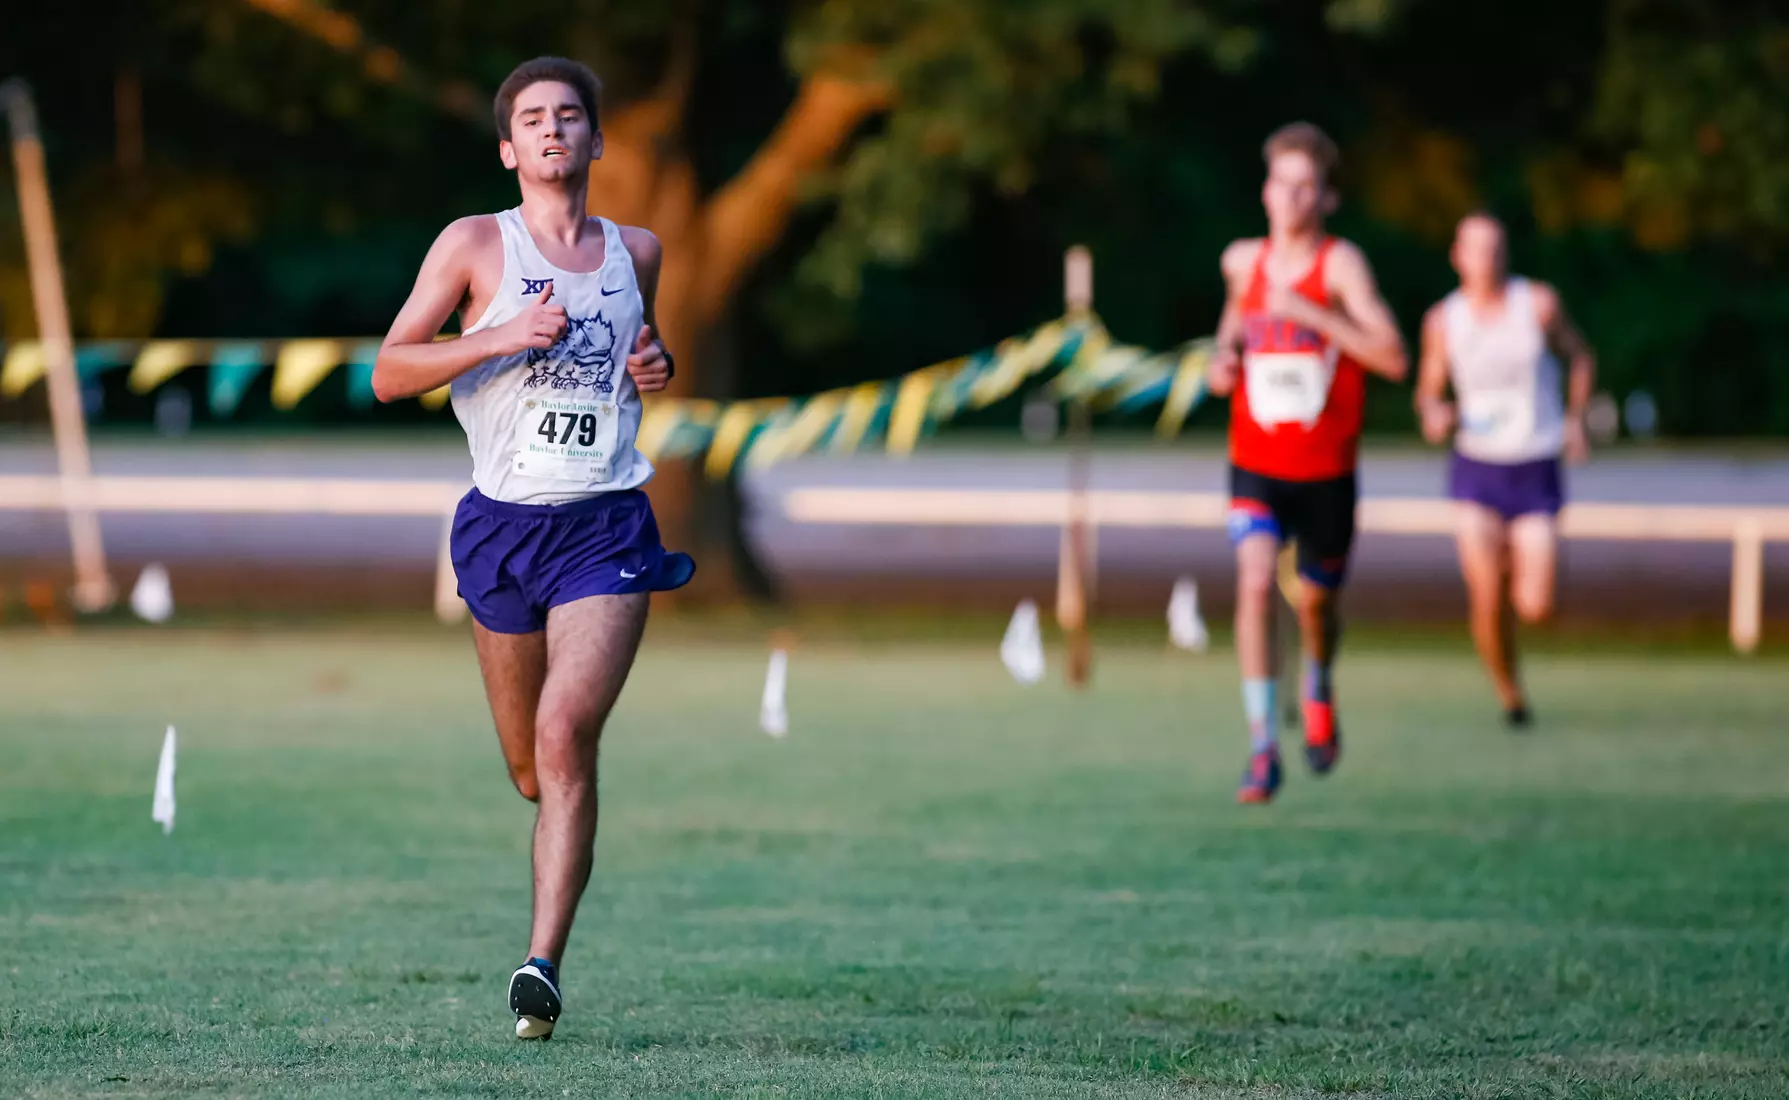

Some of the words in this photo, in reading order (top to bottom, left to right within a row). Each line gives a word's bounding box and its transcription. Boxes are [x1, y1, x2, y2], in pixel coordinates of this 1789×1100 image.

[521, 278, 555, 296] XI
[541, 400, 571, 411] Baylor
[573, 403, 598, 412] Invite
[538, 411, 597, 447] 479
[529, 443, 557, 455] Baylor
